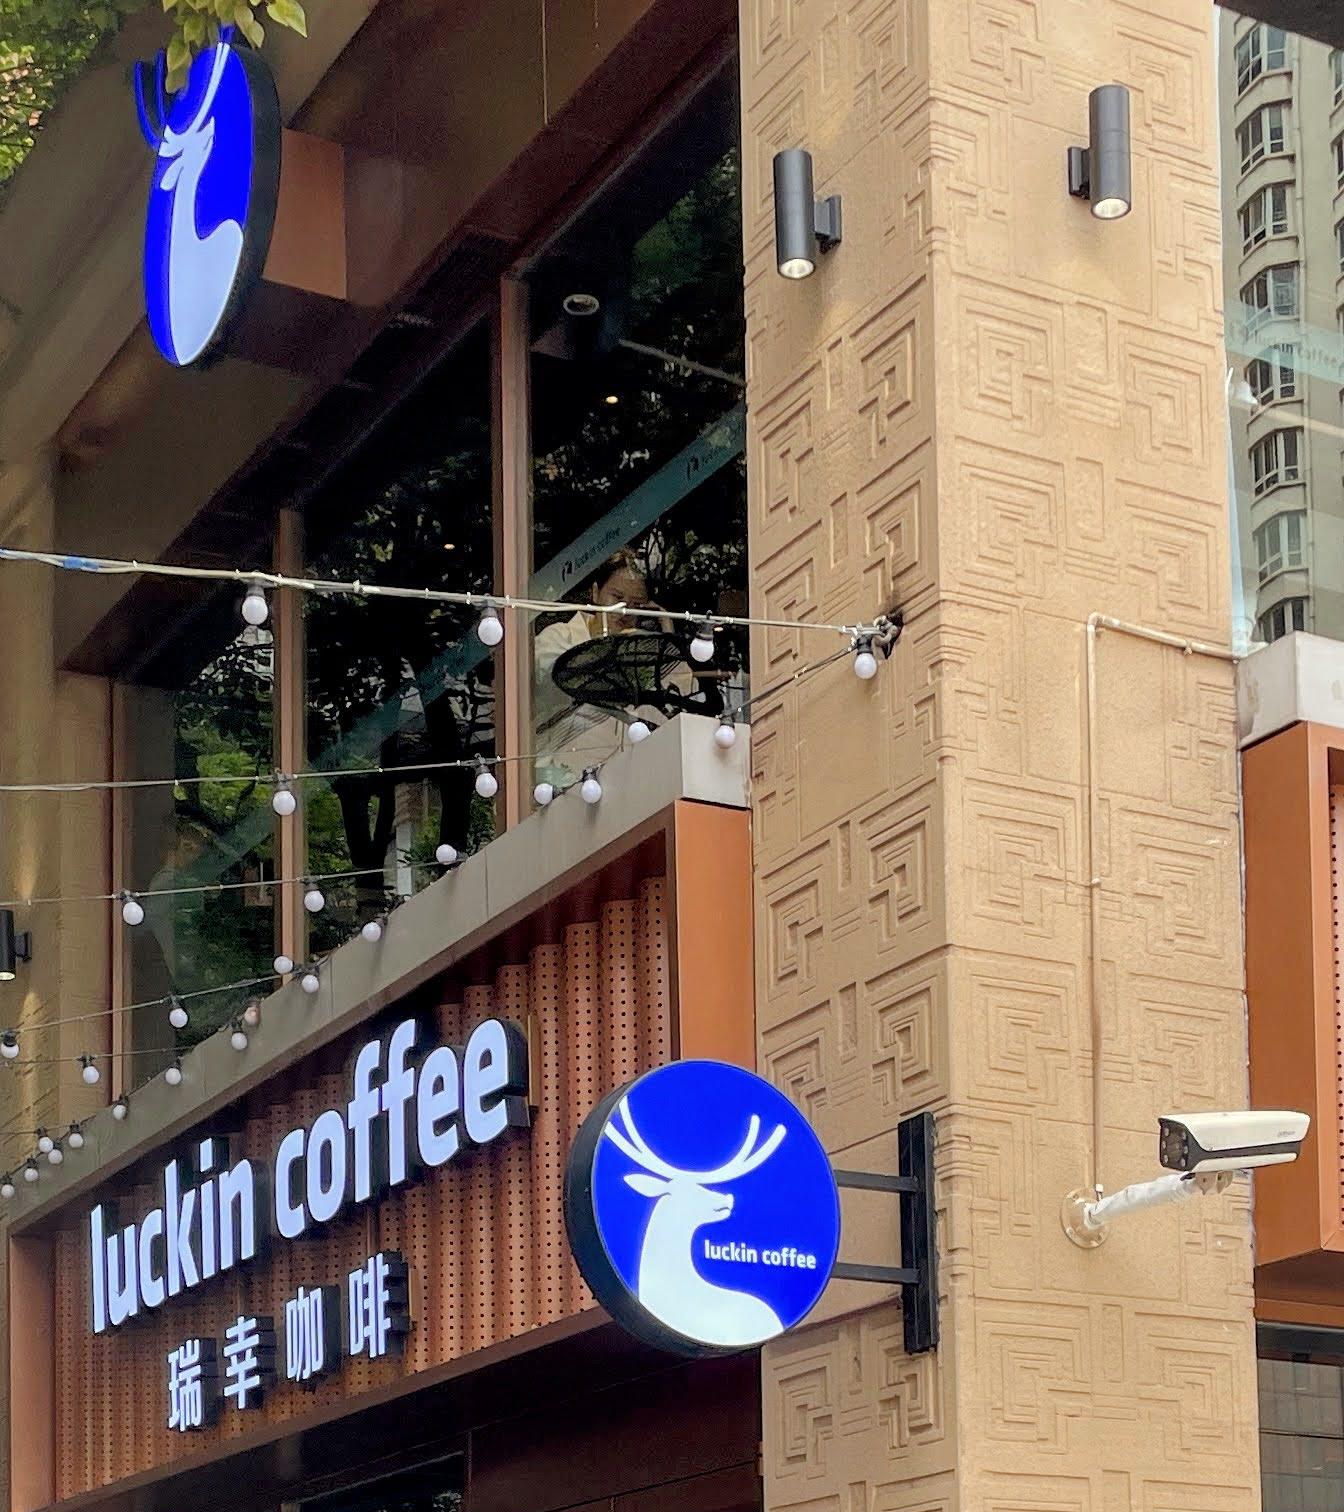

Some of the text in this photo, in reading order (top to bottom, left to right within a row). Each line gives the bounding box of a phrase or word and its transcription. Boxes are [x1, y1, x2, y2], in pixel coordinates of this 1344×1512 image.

[90, 1017, 510, 1335] luckin coffee
[704, 1239, 817, 1270] luckin coffee
[167, 1252, 391, 1432] 瑞幸咖啡
